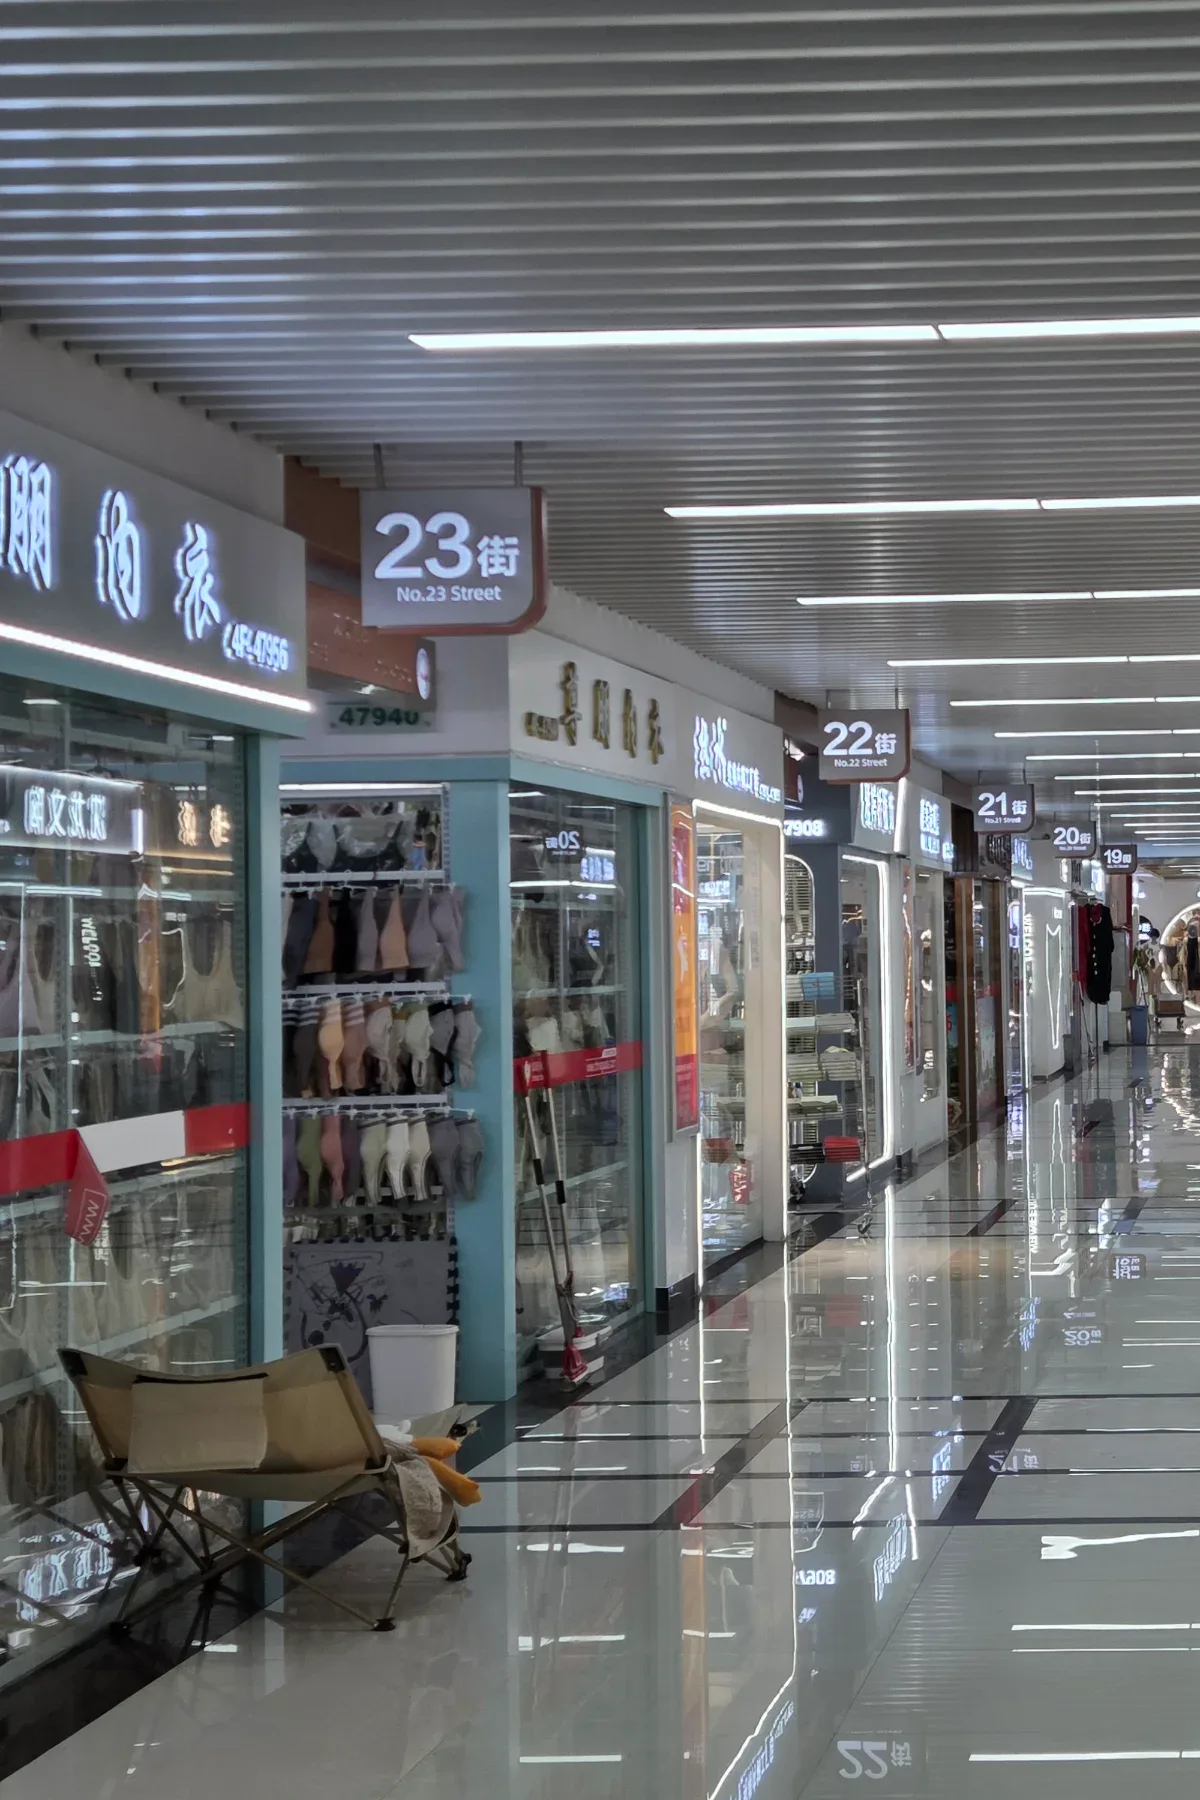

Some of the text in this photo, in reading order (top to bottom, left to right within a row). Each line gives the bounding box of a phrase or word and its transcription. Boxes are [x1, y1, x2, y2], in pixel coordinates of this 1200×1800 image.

[374, 511, 520, 580] 23街
[396, 585, 502, 602] No.23 Street
[823, 721, 897, 755] 22街
[834, 758, 887, 767] No.22 Street
[978, 792, 1027, 816] 21街
[783, 819, 823, 837] 7908
[1053, 827, 1091, 845] 20街
